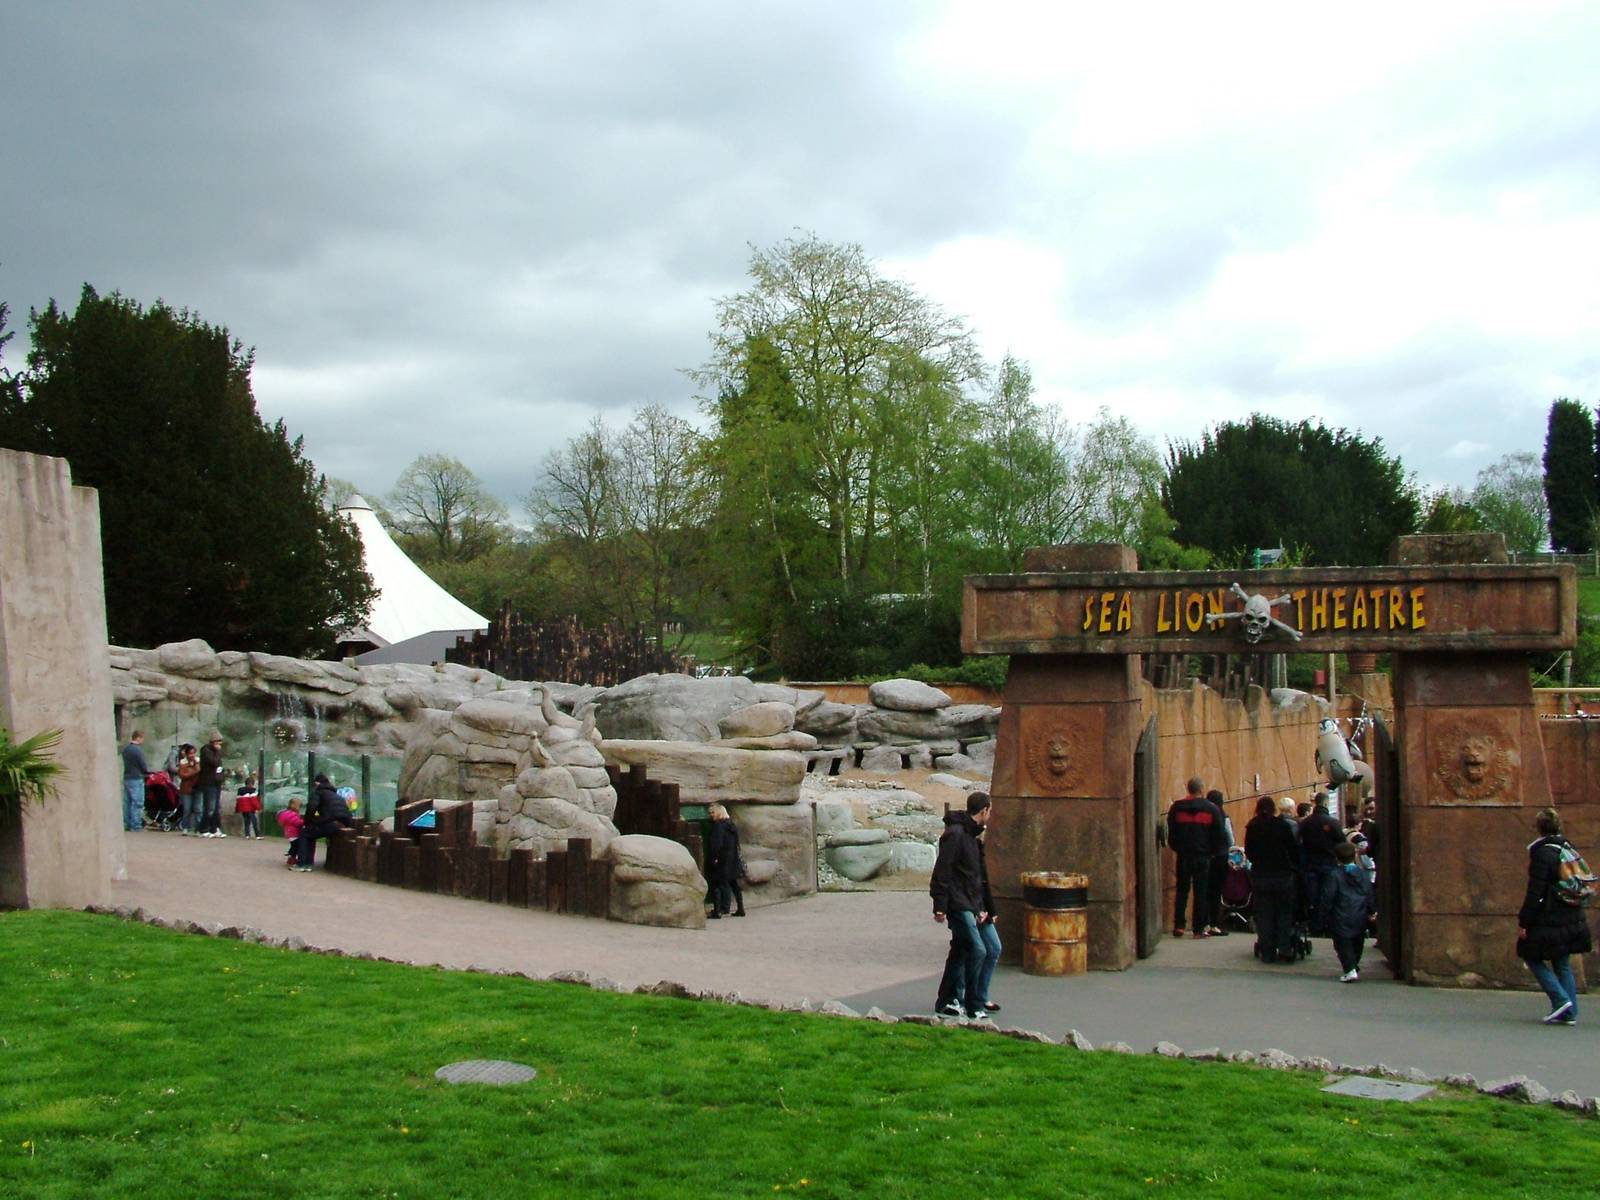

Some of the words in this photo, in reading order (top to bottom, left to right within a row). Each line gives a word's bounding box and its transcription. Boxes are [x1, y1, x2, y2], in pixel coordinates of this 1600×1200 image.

[1083, 591, 1132, 632] SEA
[1157, 588, 1225, 632] LION
[1292, 586, 1426, 631] THEATRE
